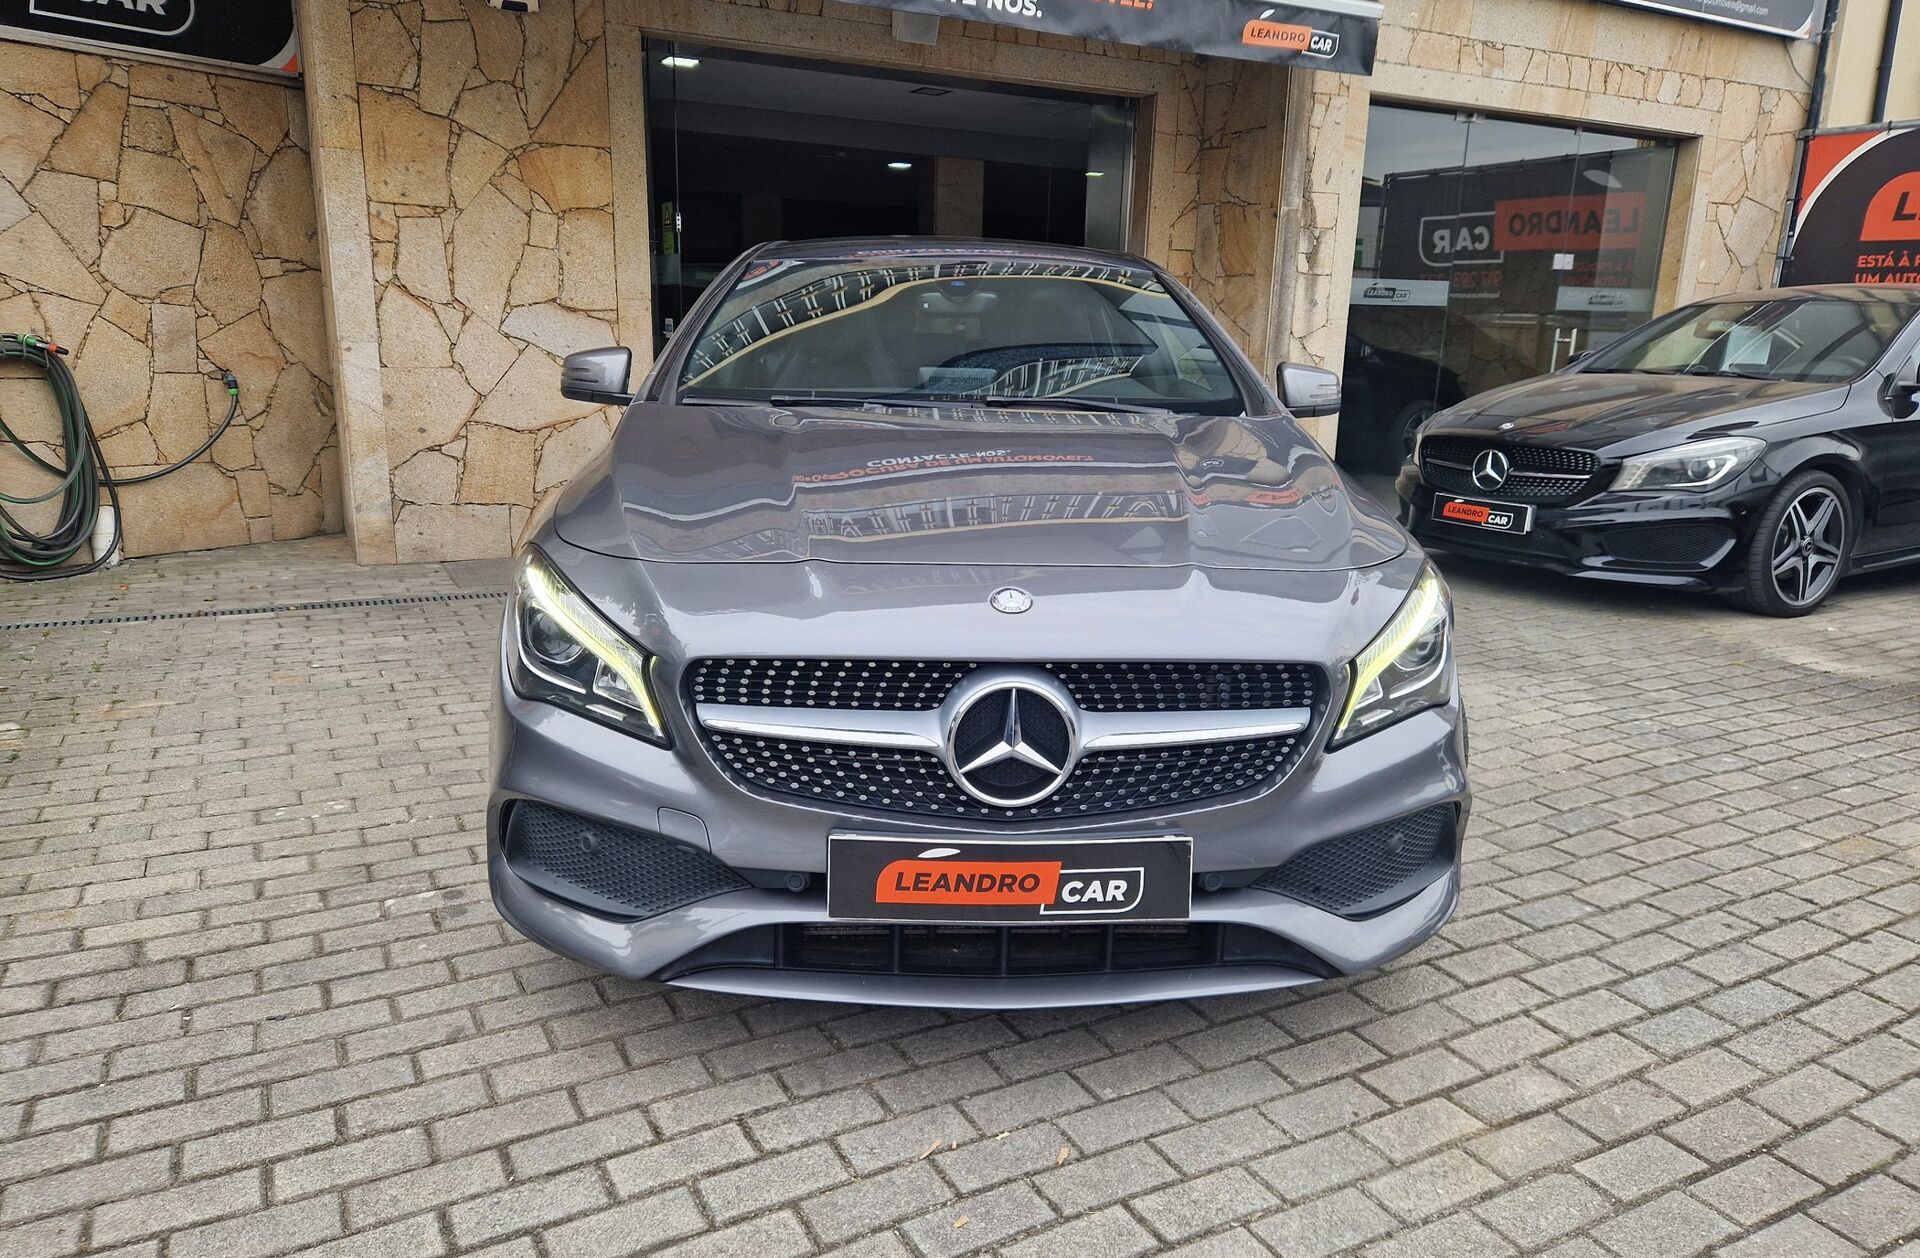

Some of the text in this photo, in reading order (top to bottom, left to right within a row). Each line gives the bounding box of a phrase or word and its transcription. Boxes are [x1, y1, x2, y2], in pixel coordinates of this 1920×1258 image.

[1250, 27, 1333, 52] LEANDRO CAR
[1857, 250, 1895, 268] ESTÁ
[1855, 272, 1880, 284] UM
[1447, 505, 1509, 526] LEANDRO CAR
[894, 871, 1128, 903] LEANDRO CAR
